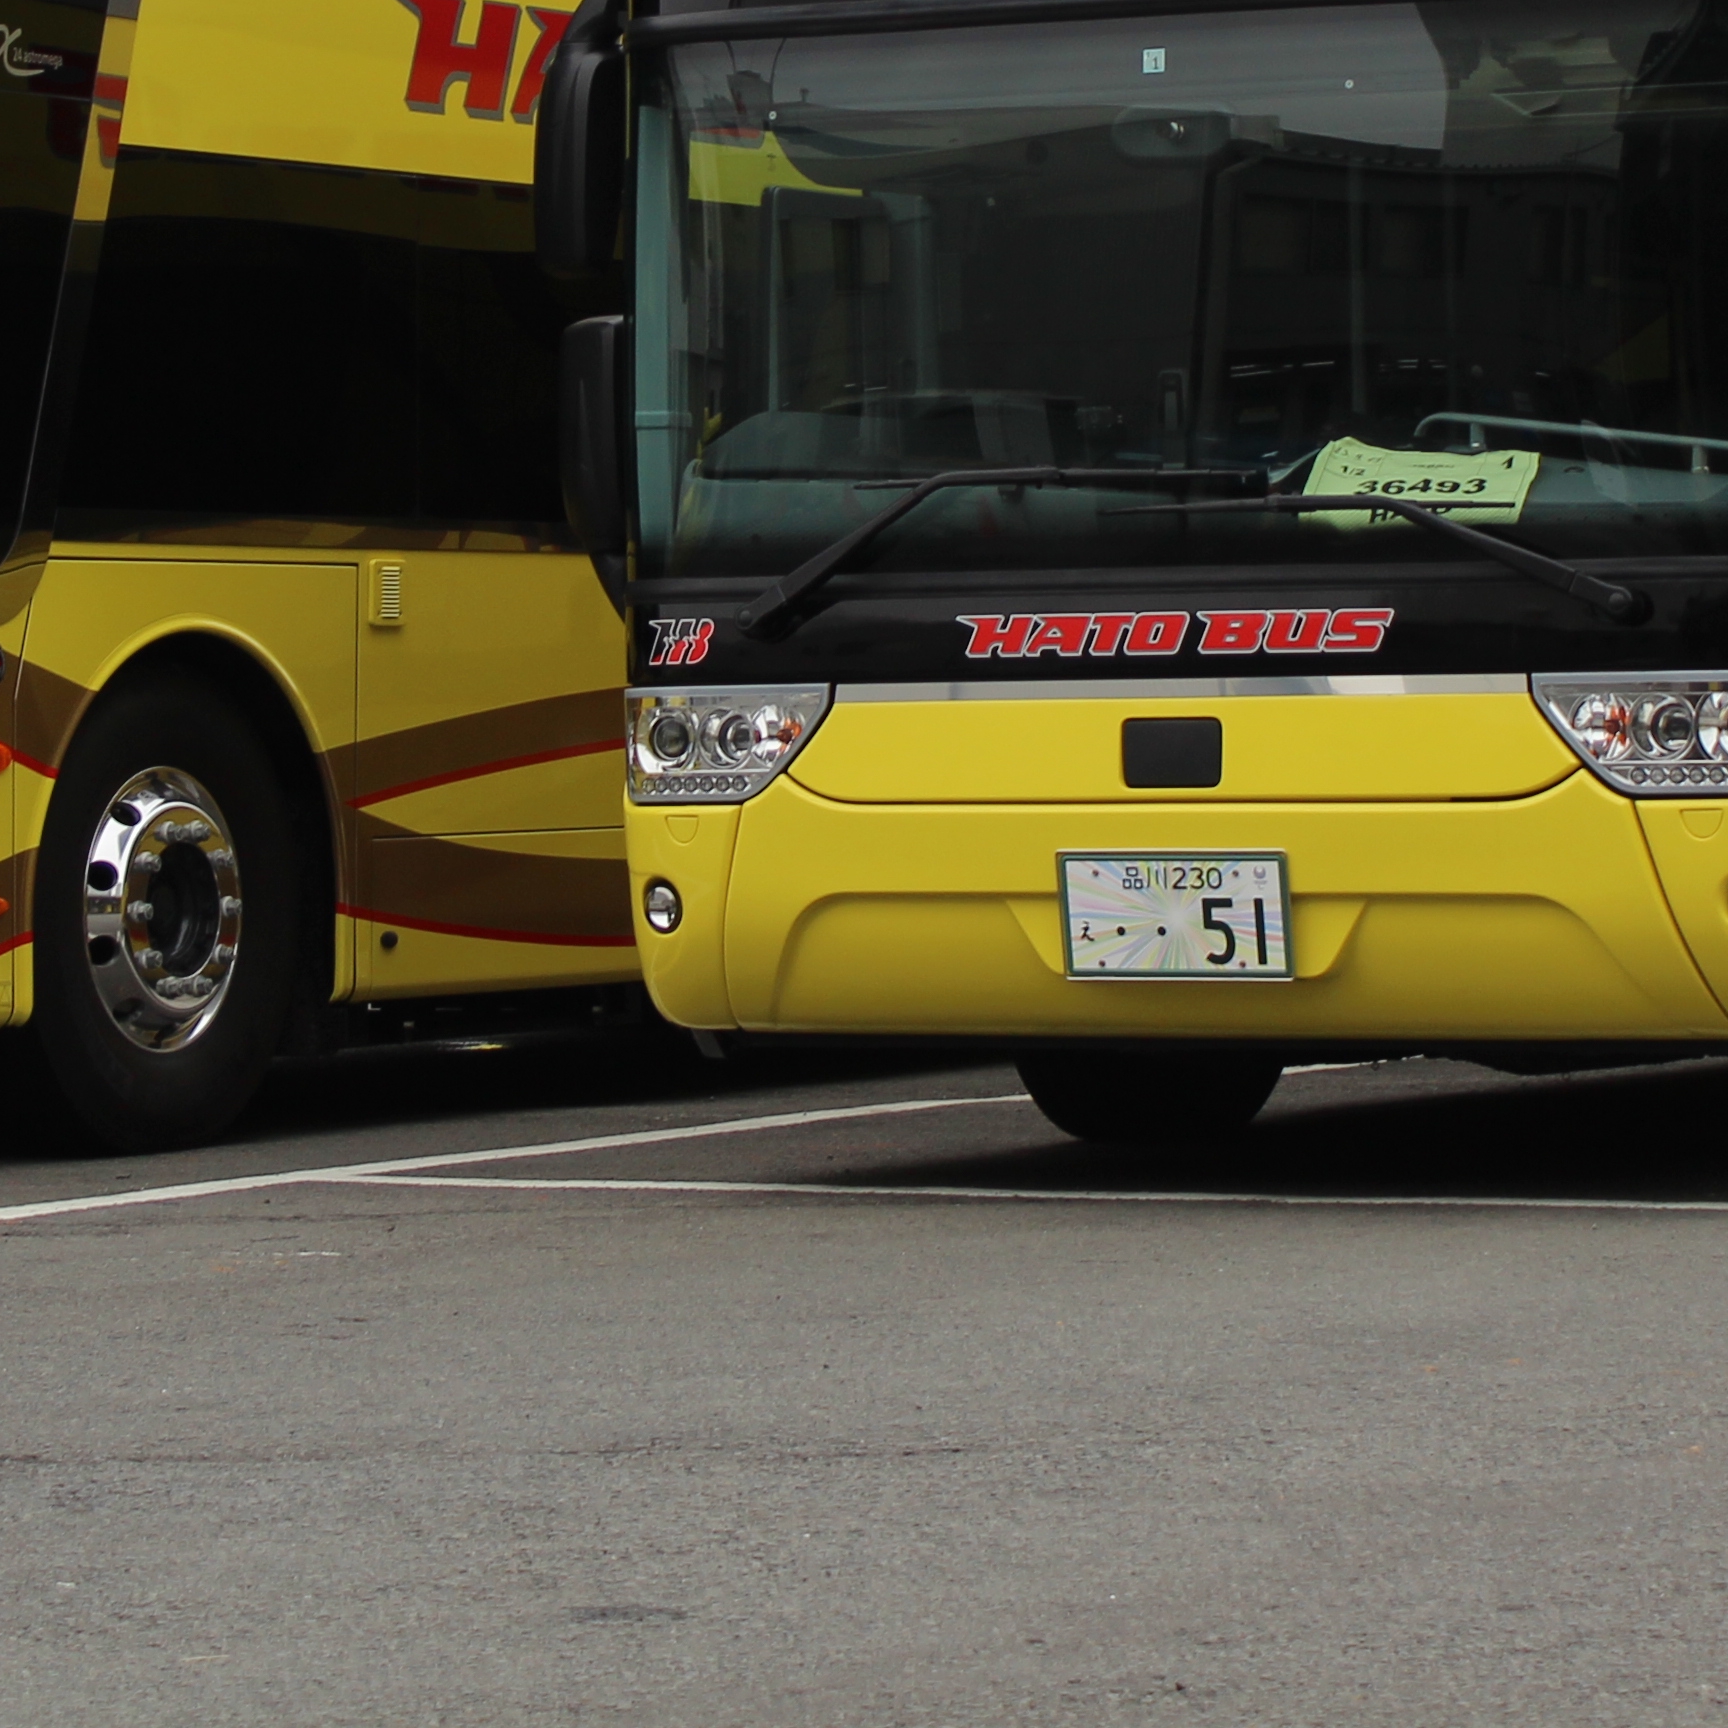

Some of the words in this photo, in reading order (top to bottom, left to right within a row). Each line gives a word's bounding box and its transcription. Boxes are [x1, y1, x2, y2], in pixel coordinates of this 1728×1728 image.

[1354, 478, 1487, 495] 36493
[956, 611, 1190, 658] HATO
[1196, 608, 1395, 655] BUS
